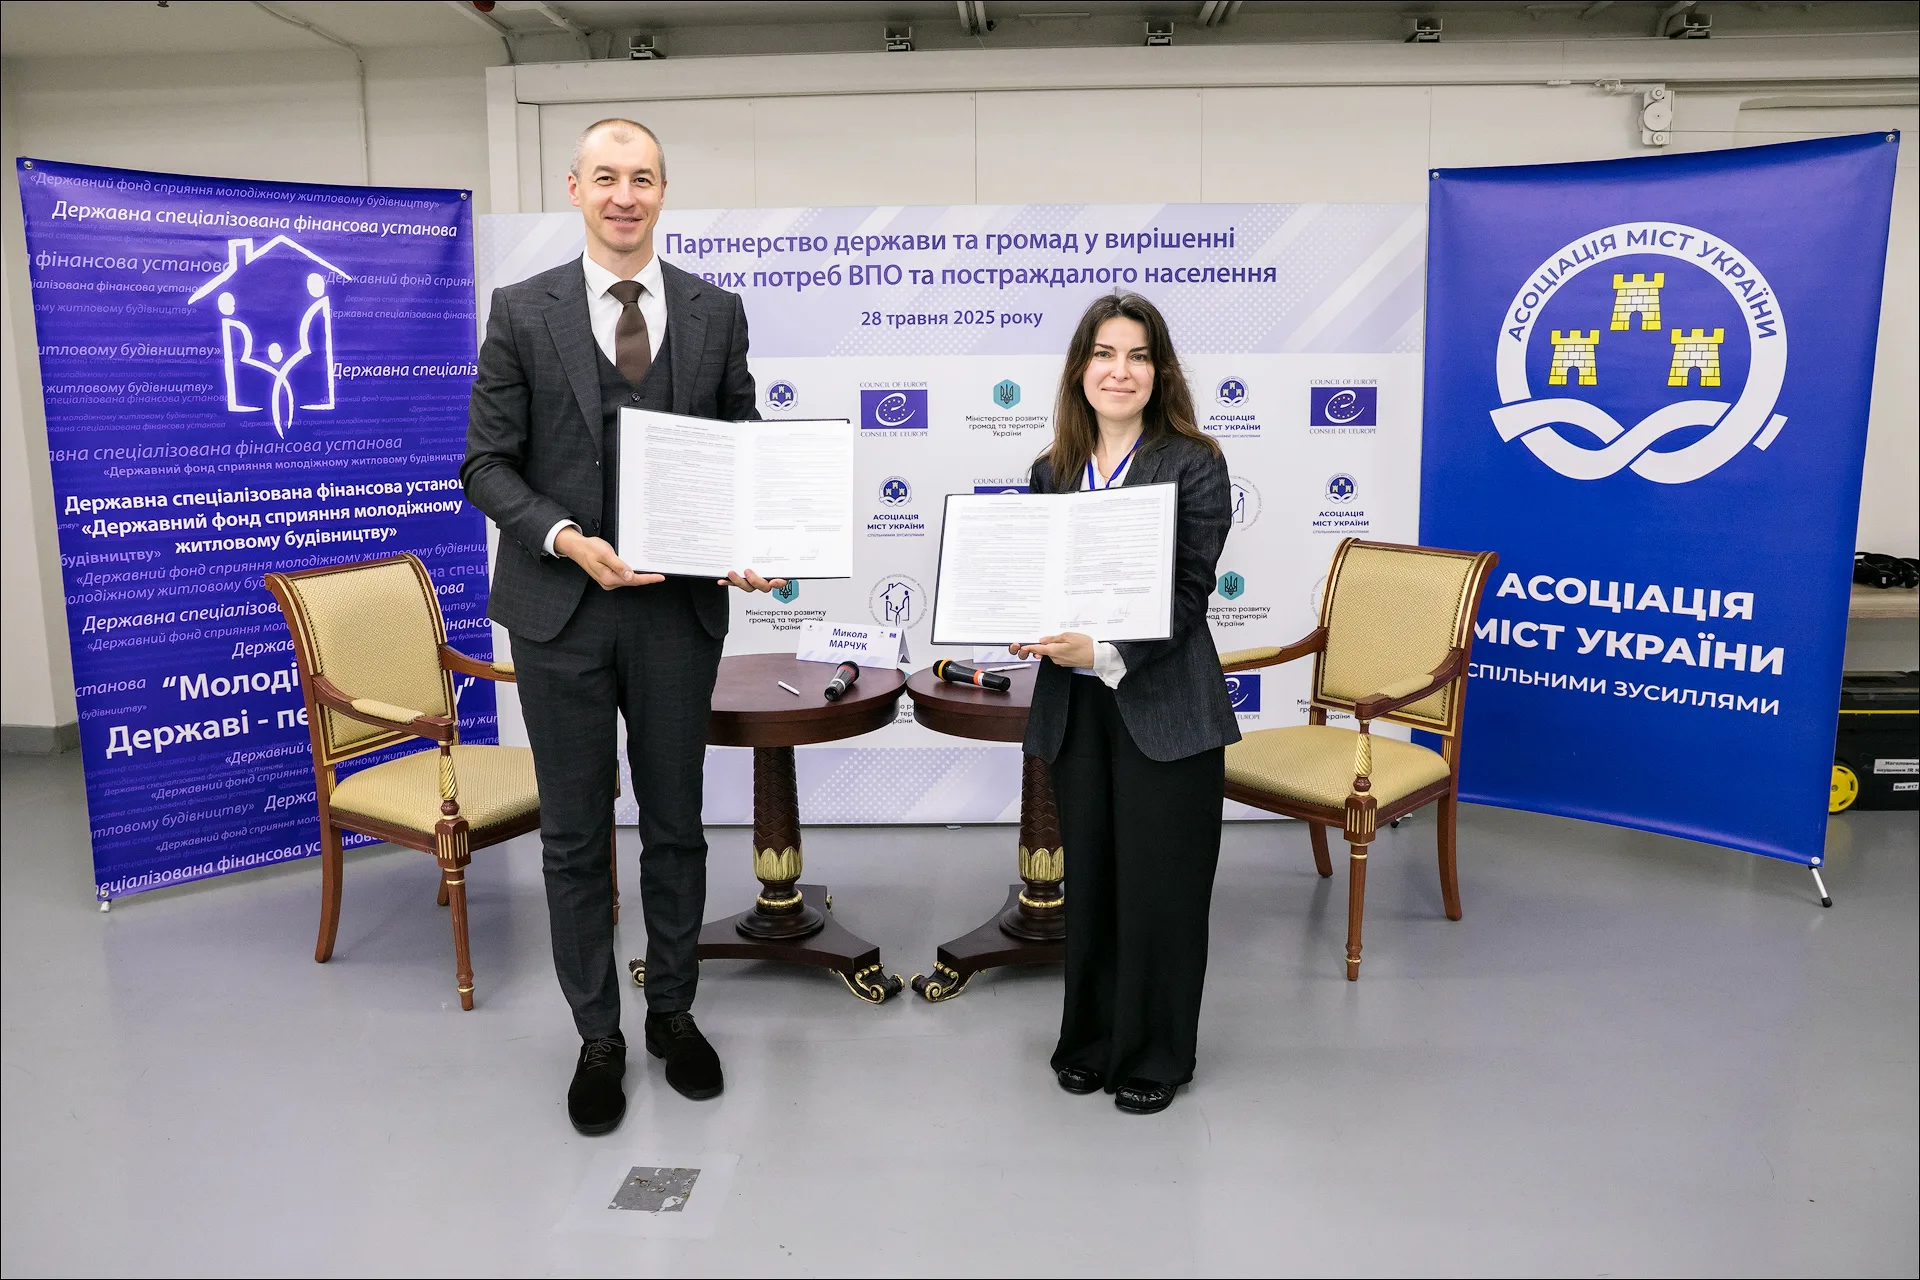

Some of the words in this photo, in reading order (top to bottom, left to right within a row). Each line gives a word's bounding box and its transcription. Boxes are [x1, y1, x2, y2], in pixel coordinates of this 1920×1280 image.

[29, 173, 114, 190] «Державний
[117, 179, 150, 193] фонд
[154, 183, 212, 196] сприяння
[216, 186, 296, 204] молодіжному
[297, 194, 365, 208] житловому
[367, 195, 440, 210] будівництву»
[52, 201, 150, 221] Державна
[155, 209, 290, 229] спеціалізована
[294, 215, 378, 234] фінансова
[381, 221, 458, 237] установа
[665, 233, 828, 258] Партнерство
[834, 233, 947, 256] держави
[953, 233, 978, 249] та
[986, 232, 1078, 254] громад
[1084, 232, 1099, 254] у
[1105, 227, 1235, 253] вирішенні
[35, 250, 138, 271] фінансова
[31, 279, 94, 292] іалізована
[97, 280, 155, 293] фінансова
[400, 275, 432, 288] фонд
[753, 264, 842, 292] потреб
[849, 264, 903, 286] ВПО
[908, 269, 934, 285] та
[941, 267, 1137, 289] постраждалого
[1145, 267, 1277, 283] населення
[1508, 233, 1617, 343] АСОЦІАЦІЯ
[1626, 228, 1694, 252] МІСТ
[1696, 240, 1778, 339] УКРАЇНИ
[57, 304, 123, 315] житловому
[125, 304, 197, 316] будівництву»
[375, 309, 441, 321] спеціалізована
[861, 311, 881, 326] 28
[886, 312, 948, 328] травня
[953, 310, 995, 326] 2025
[1000, 312, 1043, 328] року
[120, 343, 221, 359] будівництву»
[332, 362, 409, 380] Державна
[46, 384, 125, 395] житловому
[127, 382, 213, 396] будівництву»
[965, 415, 1013, 423] Міністерство
[1014, 415, 1048, 424] розвитку
[968, 423, 997, 431] громад
[1009, 422, 1045, 430] територій
[1209, 414, 1256, 422] АСОЦІАЦІЯ
[1224, 423, 1261, 431] УКРАЇНИ
[992, 430, 1022, 438] України
[93, 442, 232, 460] спеціалізована
[235, 439, 321, 459] фінансова
[325, 437, 402, 456] установа
[103, 465, 181, 479] «Державний
[184, 464, 215, 476] фонд
[217, 461, 273, 474] сприяння
[275, 459, 349, 471] молодіжному
[351, 456, 408, 467] житловому
[65, 495, 168, 515] Державна
[172, 487, 312, 508] спеціалізована
[316, 482, 403, 502] фінансова
[81, 513, 207, 538] «Державний
[212, 511, 261, 531] фонд
[265, 506, 350, 527] сприяння
[354, 500, 463, 519] молодіжному
[873, 514, 919, 522] АСОЦІАЦІЯ
[888, 522, 924, 530] УКРАЇНИ
[1333, 519, 1370, 527] УКРАЇНИ
[175, 534, 281, 554] житловому
[284, 527, 398, 548] будівництву»
[76, 567, 166, 587] «Державний
[169, 564, 206, 581] фонд
[208, 560, 272, 577] сприяння
[275, 552, 361, 571] молодіжному
[157, 579, 242, 597] житловому
[1496, 572, 1755, 621] АСОЦІАЦІЯ
[745, 609, 793, 618] Міністерство
[793, 610, 826, 618] розвитку
[1208, 606, 1237, 614] терство
[1239, 606, 1271, 614] розвитку
[1231, 613, 1268, 621] територій
[82, 610, 175, 634] Державна
[748, 617, 775, 625] громад
[772, 624, 800, 632] України
[1216, 620, 1245, 628] України
[87, 631, 166, 651] «Державний
[168, 626, 201, 644] фонд
[203, 624, 261, 641] сприяння
[832, 628, 868, 640] Микола
[829, 638, 868, 651] МАРЧУК
[1473, 617, 1565, 650] МІСТ
[1576, 626, 1785, 676] УКРАЇНИ
[1467, 663, 1607, 694] СПІЛЬНИМИ
[1613, 680, 1780, 716] ЗУСИЛЛЯМИ
[81, 704, 147, 720] будівництву»
[105, 709, 250, 760] Державі
[225, 743, 304, 766] «Державний
[150, 778, 223, 801] «Державний
[225, 772, 256, 791] фонд
[257, 767, 309, 784] сприяння
[162, 802, 255, 826] будівництву»
[156, 832, 219, 852] «Державний
[221, 826, 248, 843] фонд
[249, 820, 295, 836] сприяння
[217, 844, 301, 873] фінансова
